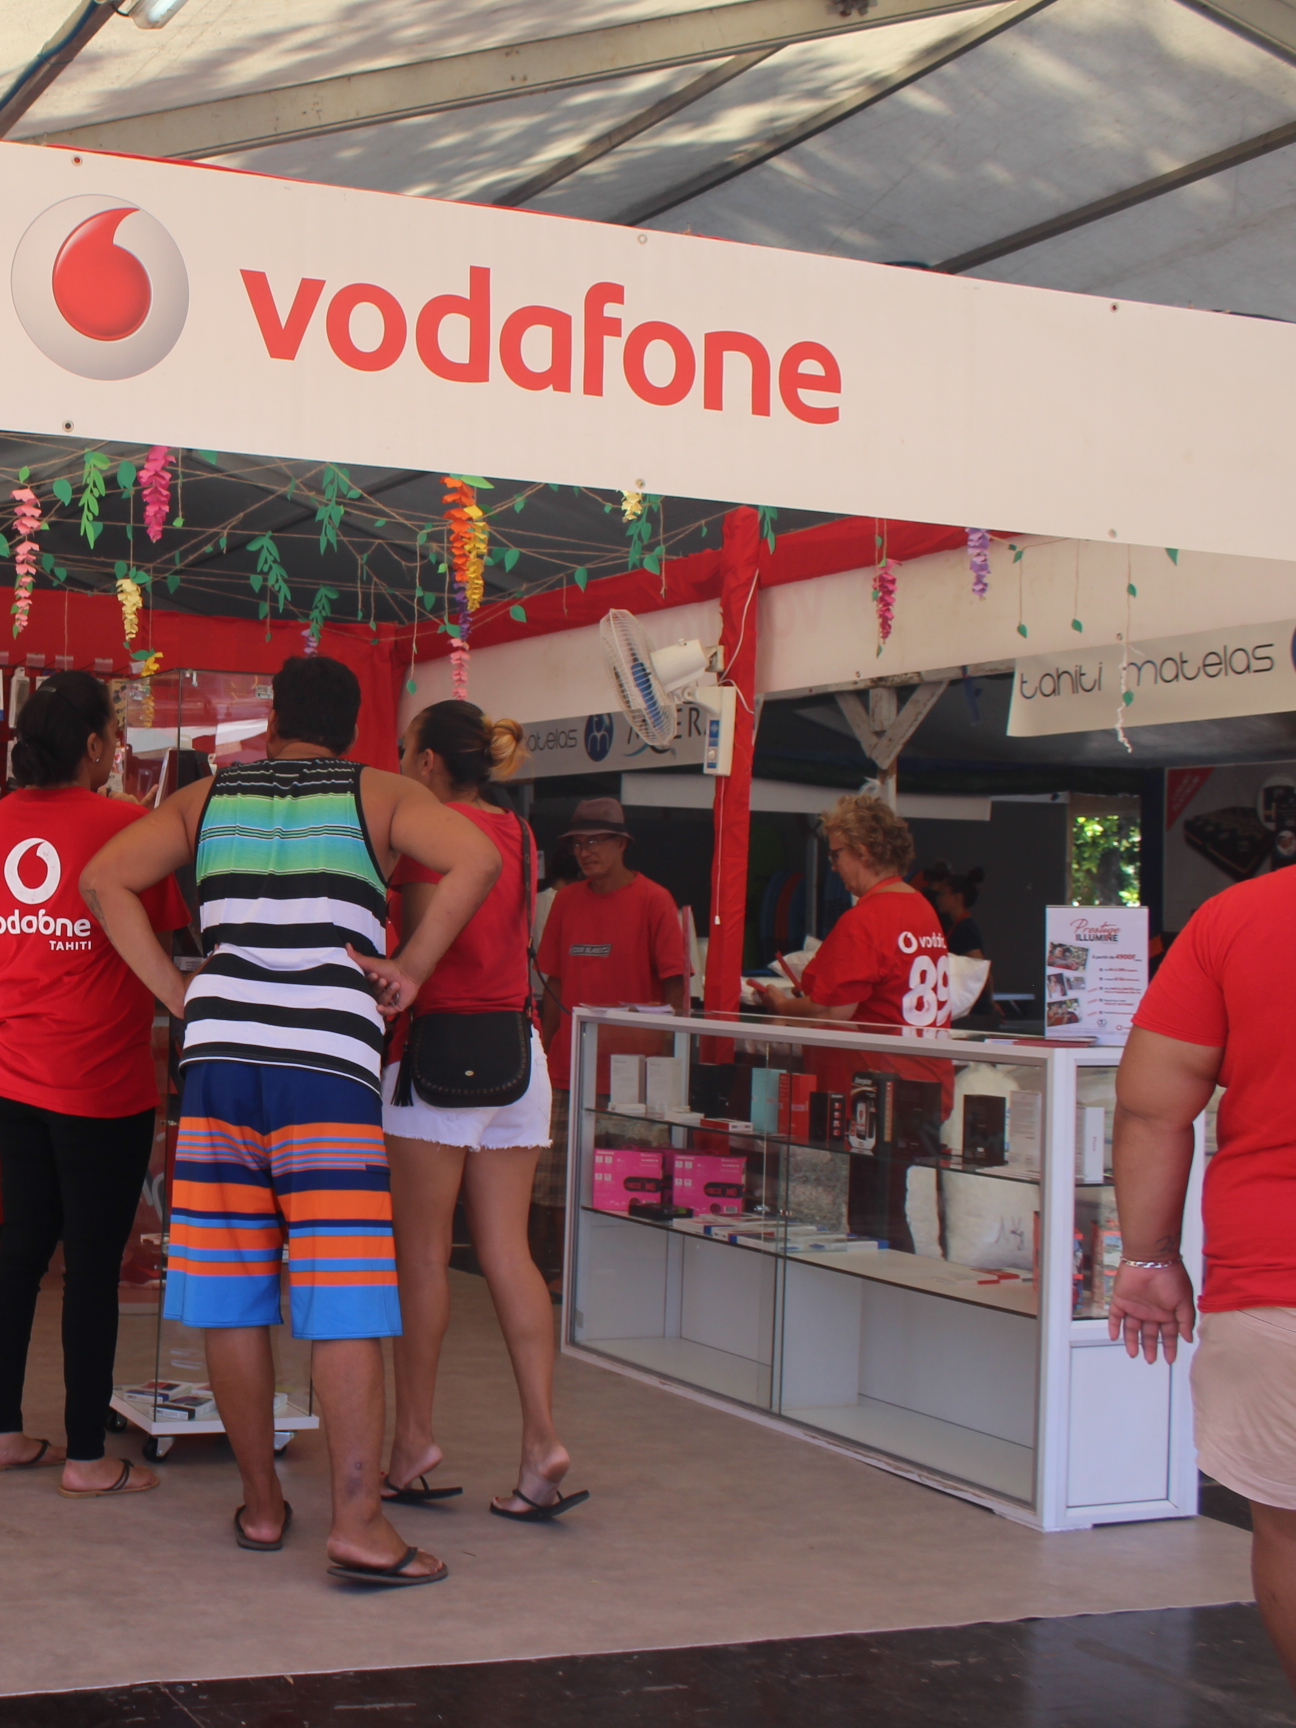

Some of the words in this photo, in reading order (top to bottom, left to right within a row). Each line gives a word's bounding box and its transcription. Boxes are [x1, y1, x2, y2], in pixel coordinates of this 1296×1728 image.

[239, 264, 842, 425] vodafone
[1019, 661, 1103, 700] tahiti
[1122, 643, 1275, 687] matelas
[523, 728, 578, 752] atelas
[49, 940, 92, 951] TAHITI
[902, 954, 952, 1027] 89
